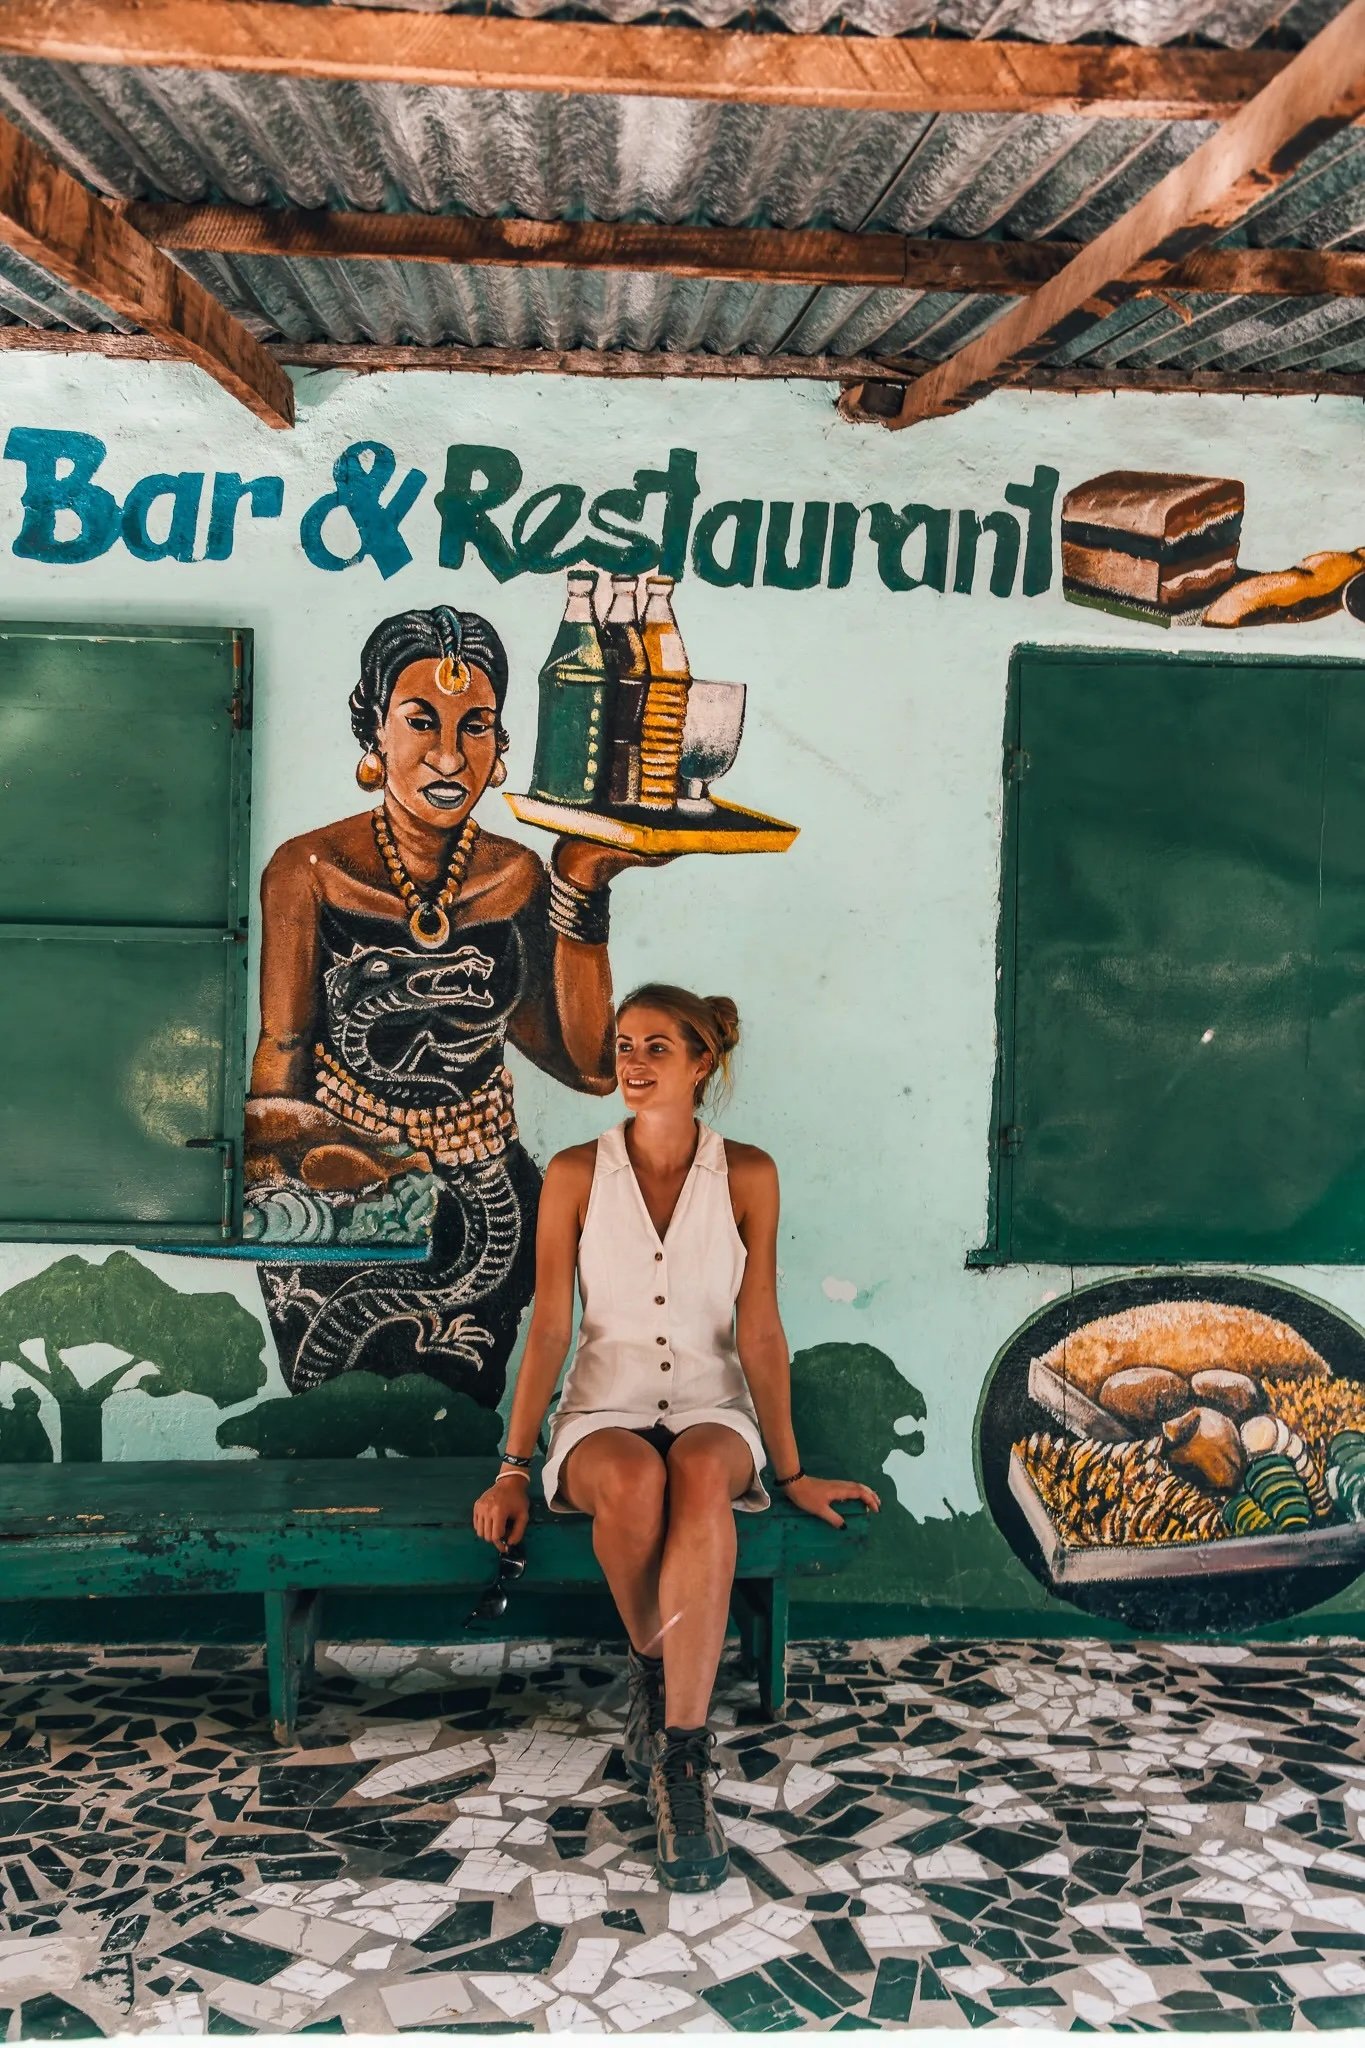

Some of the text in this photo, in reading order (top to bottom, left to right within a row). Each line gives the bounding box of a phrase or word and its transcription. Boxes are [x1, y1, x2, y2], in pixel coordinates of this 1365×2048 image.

[3, 427, 1059, 598] Bar & Restaurant
